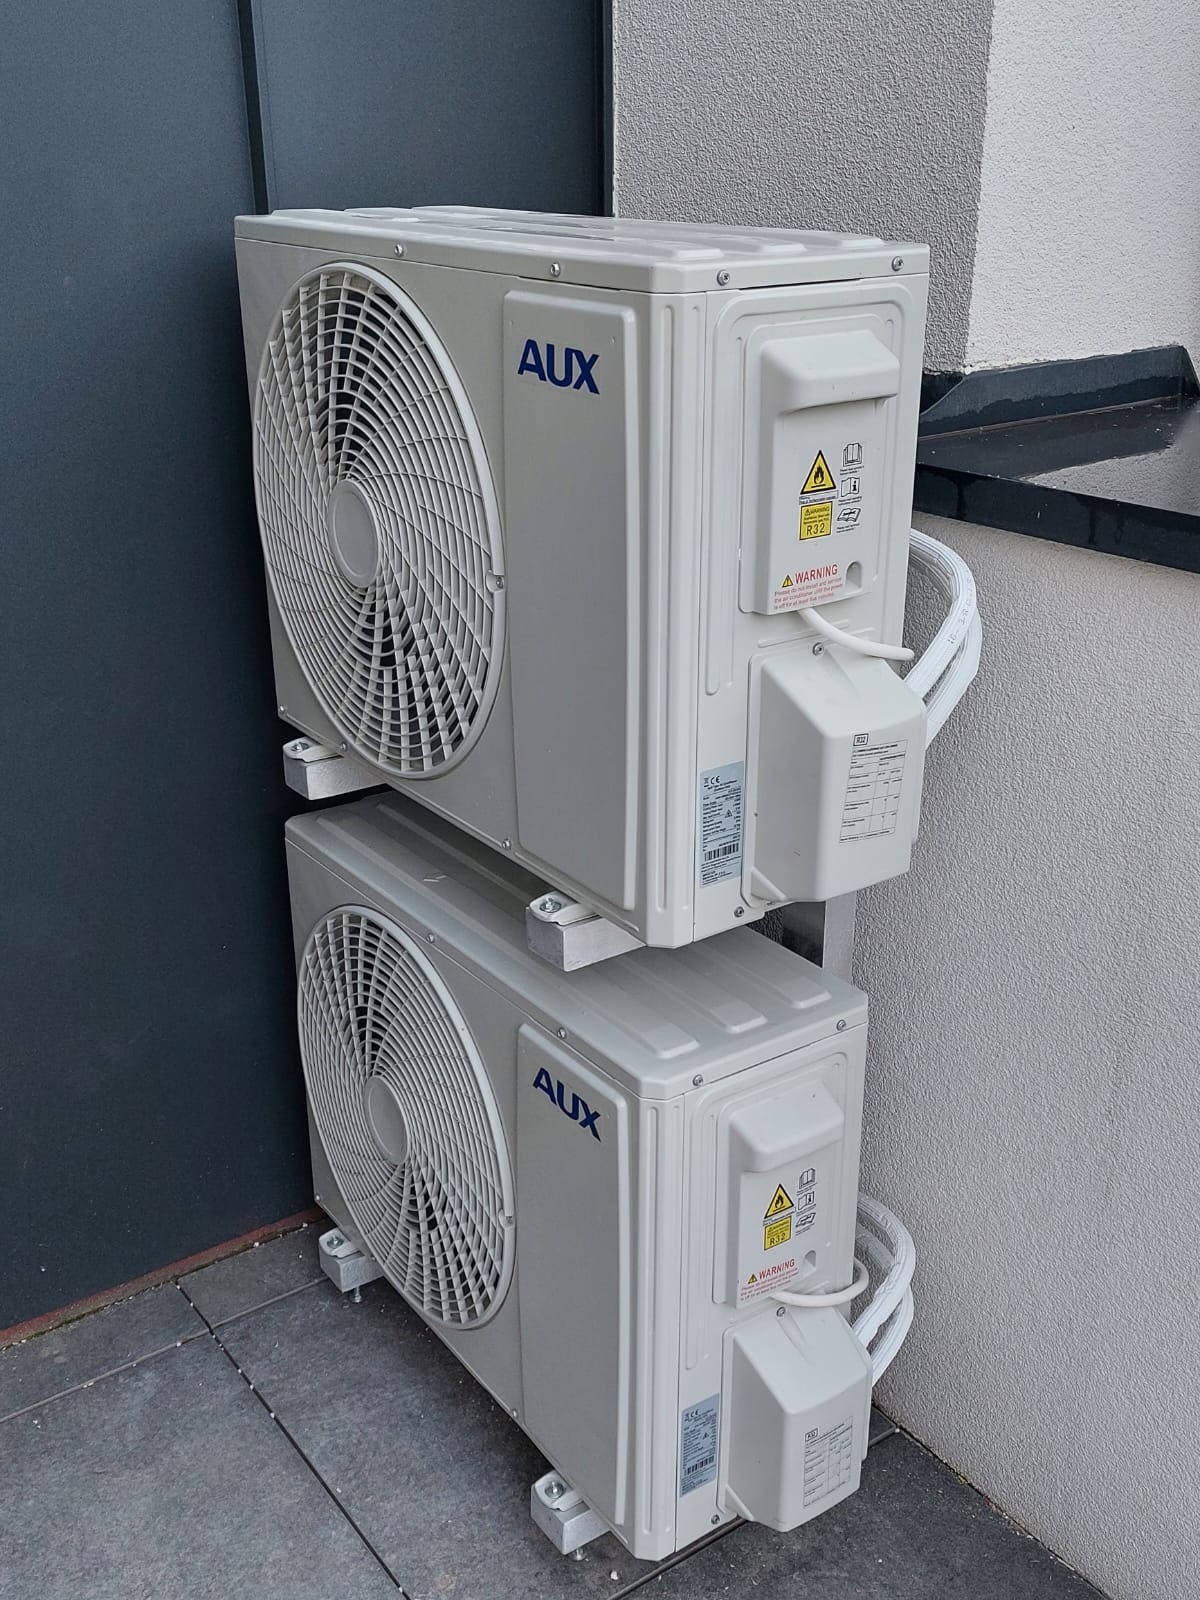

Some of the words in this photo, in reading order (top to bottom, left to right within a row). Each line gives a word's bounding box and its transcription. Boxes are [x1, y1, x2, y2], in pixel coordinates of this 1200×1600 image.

[517, 338, 600, 395] AUX
[806, 522, 825, 537] R32
[795, 563, 838, 585] WARNING
[532, 1067, 602, 1143] AUX
[769, 1232, 786, 1246] R32
[758, 1258, 795, 1280] WARNING
